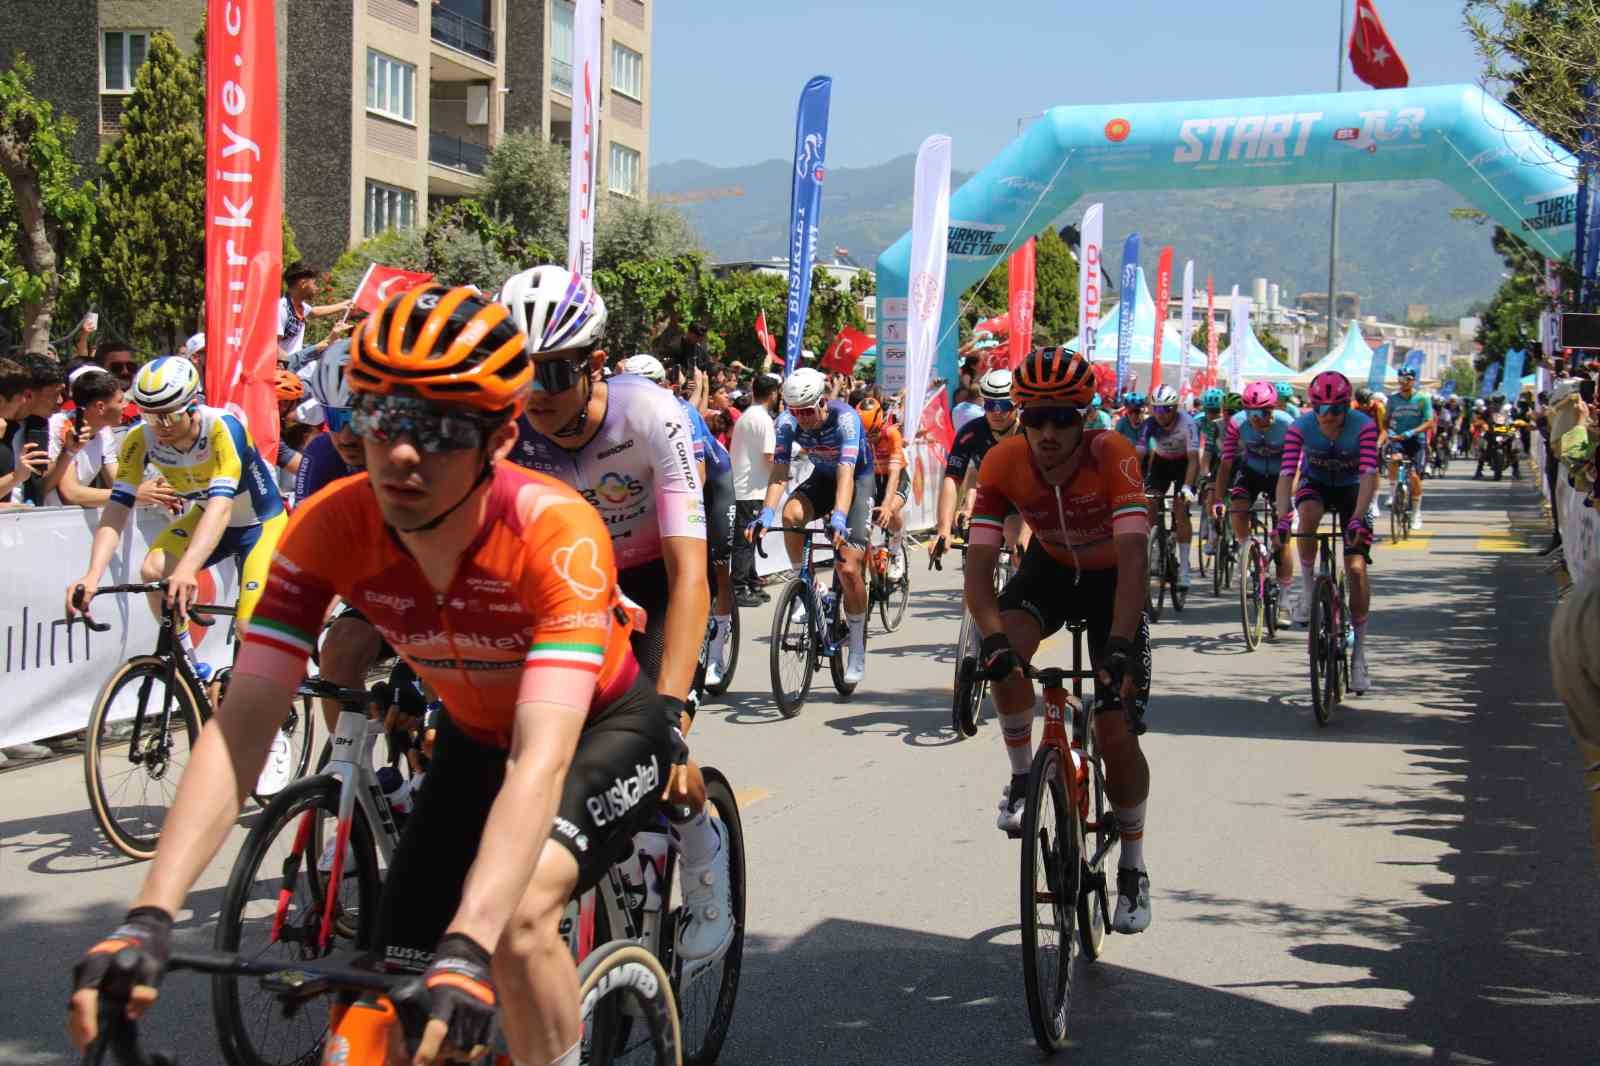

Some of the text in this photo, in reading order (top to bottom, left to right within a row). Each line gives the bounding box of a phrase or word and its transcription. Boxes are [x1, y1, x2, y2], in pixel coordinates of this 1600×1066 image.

[1173, 112, 1323, 163] START
[1085, 244, 1099, 320] TOTO
[675, 441, 697, 490] CORTIZO
[586, 754, 660, 827] euskaltel
